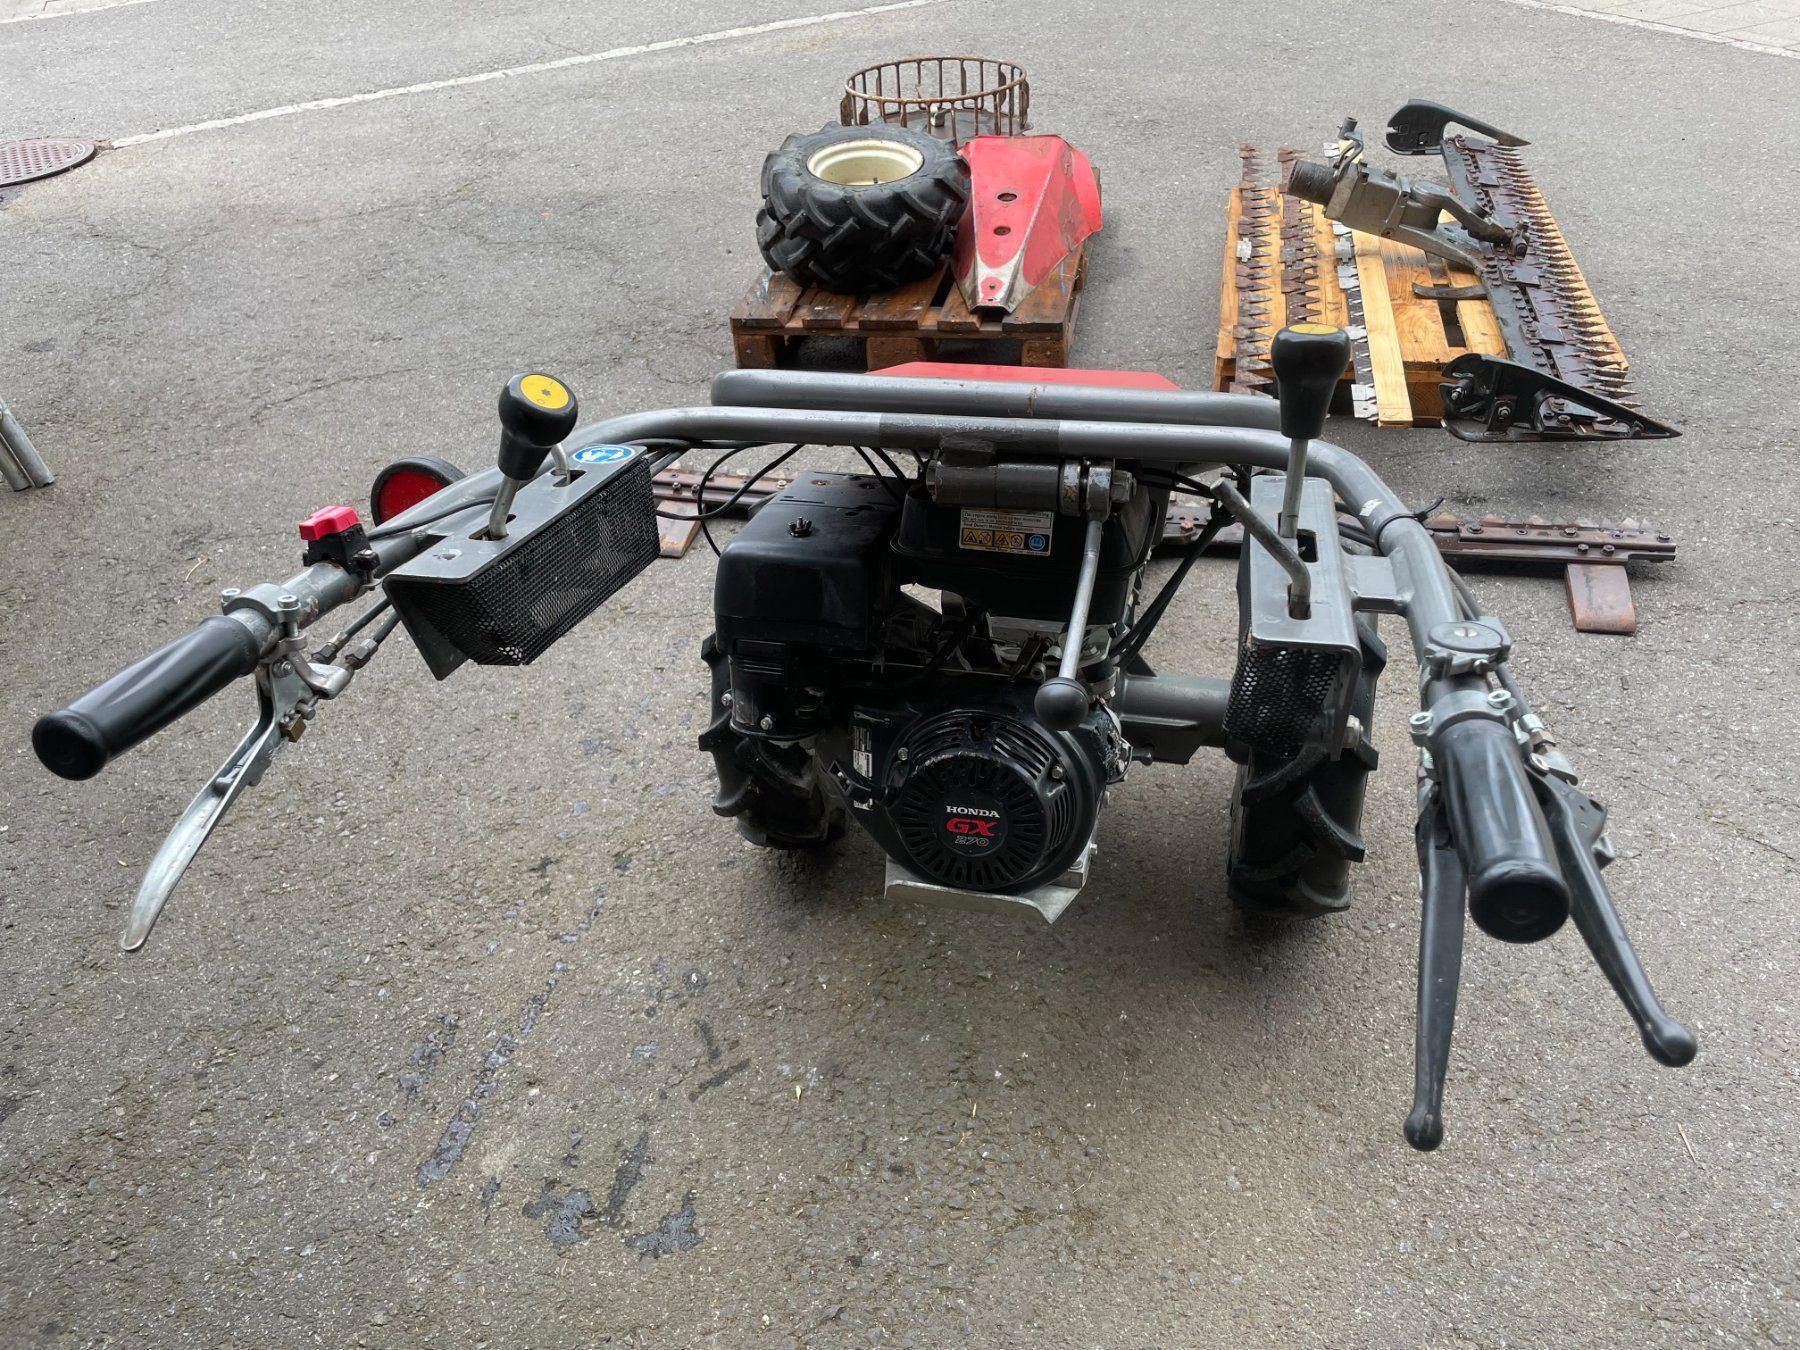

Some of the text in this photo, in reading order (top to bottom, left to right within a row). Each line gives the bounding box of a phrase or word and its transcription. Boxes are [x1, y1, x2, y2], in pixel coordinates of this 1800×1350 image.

[946, 805, 1000, 818] HONDA
[946, 817, 998, 836] GX
[955, 835, 989, 847] 270
